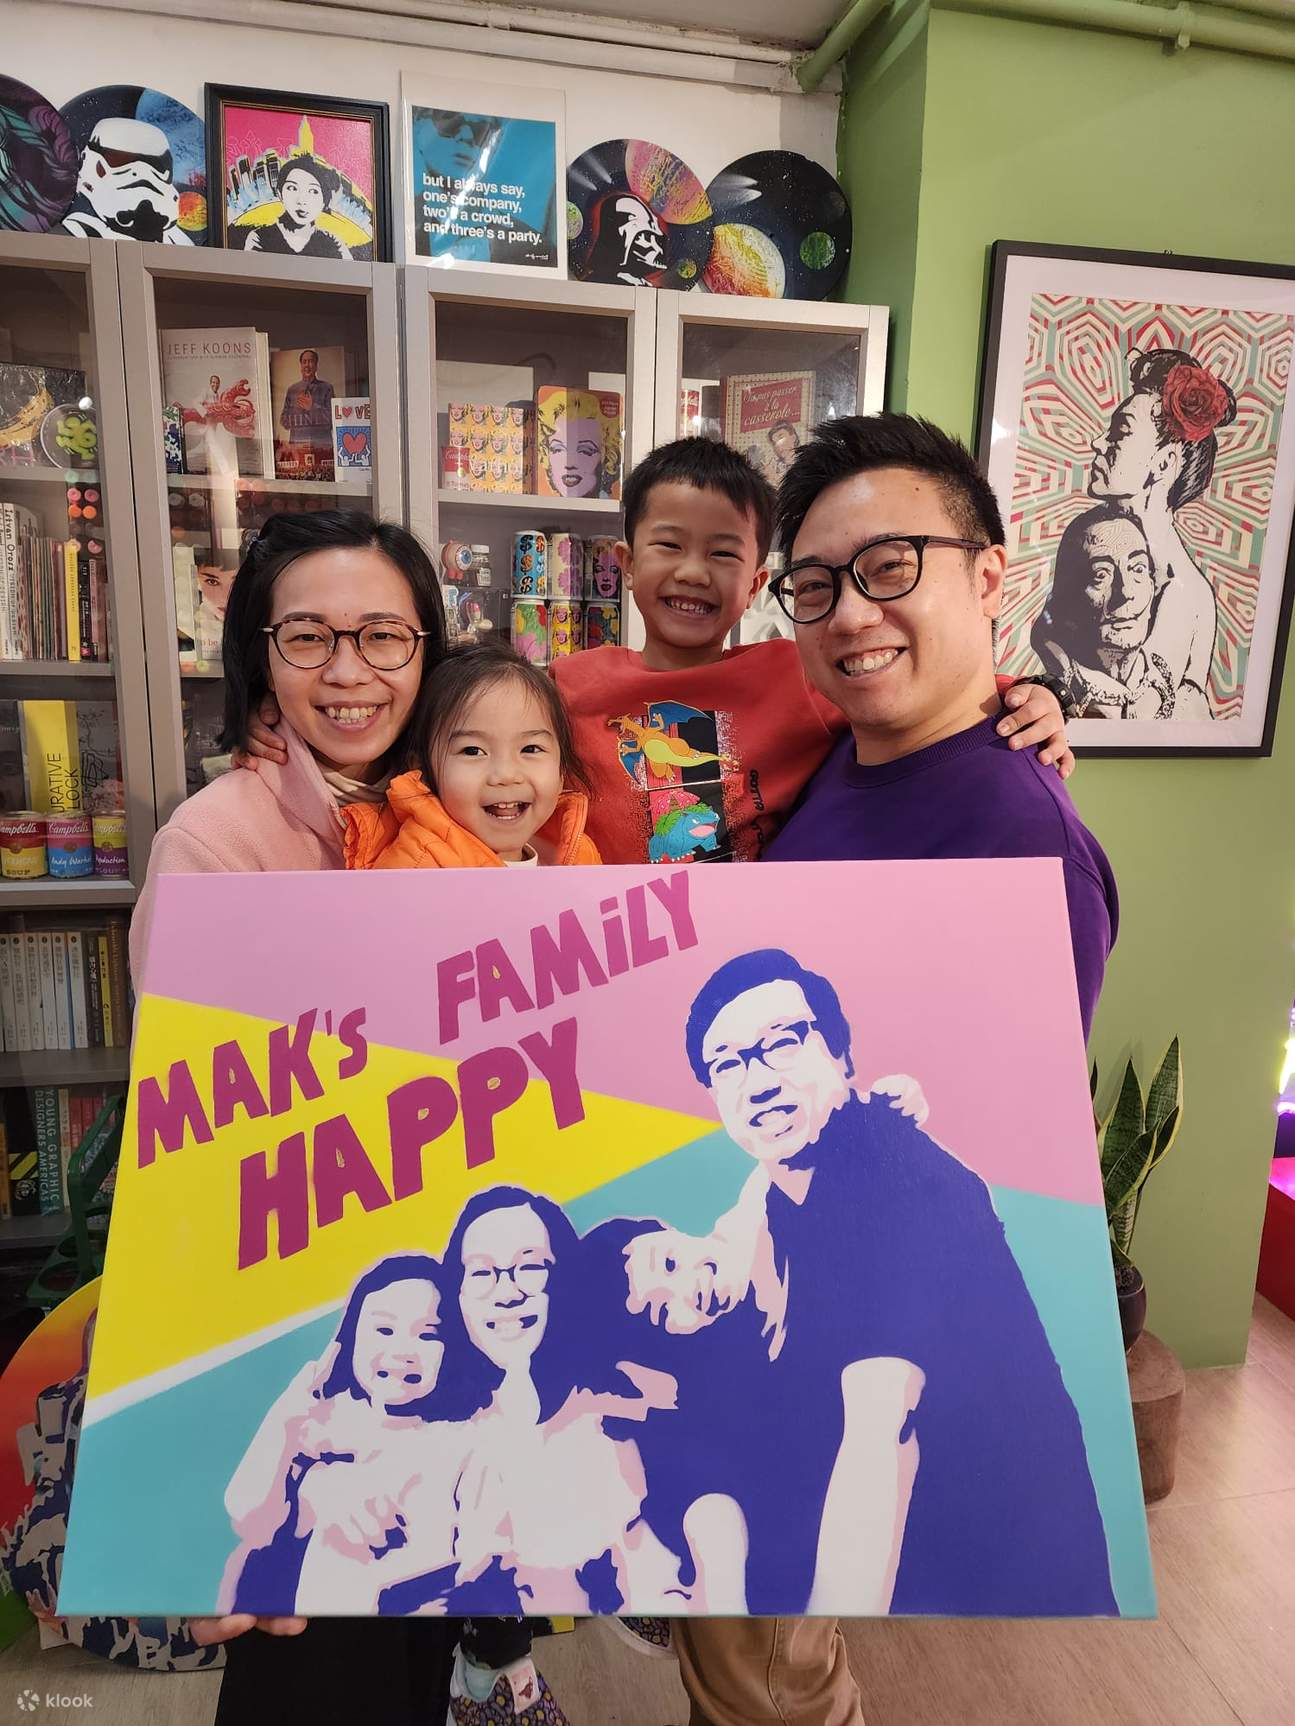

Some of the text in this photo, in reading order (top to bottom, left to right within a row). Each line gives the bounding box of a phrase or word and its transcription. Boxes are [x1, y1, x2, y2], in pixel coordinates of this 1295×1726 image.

[423, 173, 526, 198] but I alays say,
[423, 192, 522, 213] one's company,
[423, 205, 514, 228] two' a crowd,
[424, 222, 543, 245] and three's a party.
[168, 342, 252, 354] JEFF KOONS
[35, 1090, 46, 1146] DESIGNERS
[45, 1089, 60, 1202] YOUNG GRAPHIC
[238, 1016, 586, 1270] HAPPY
